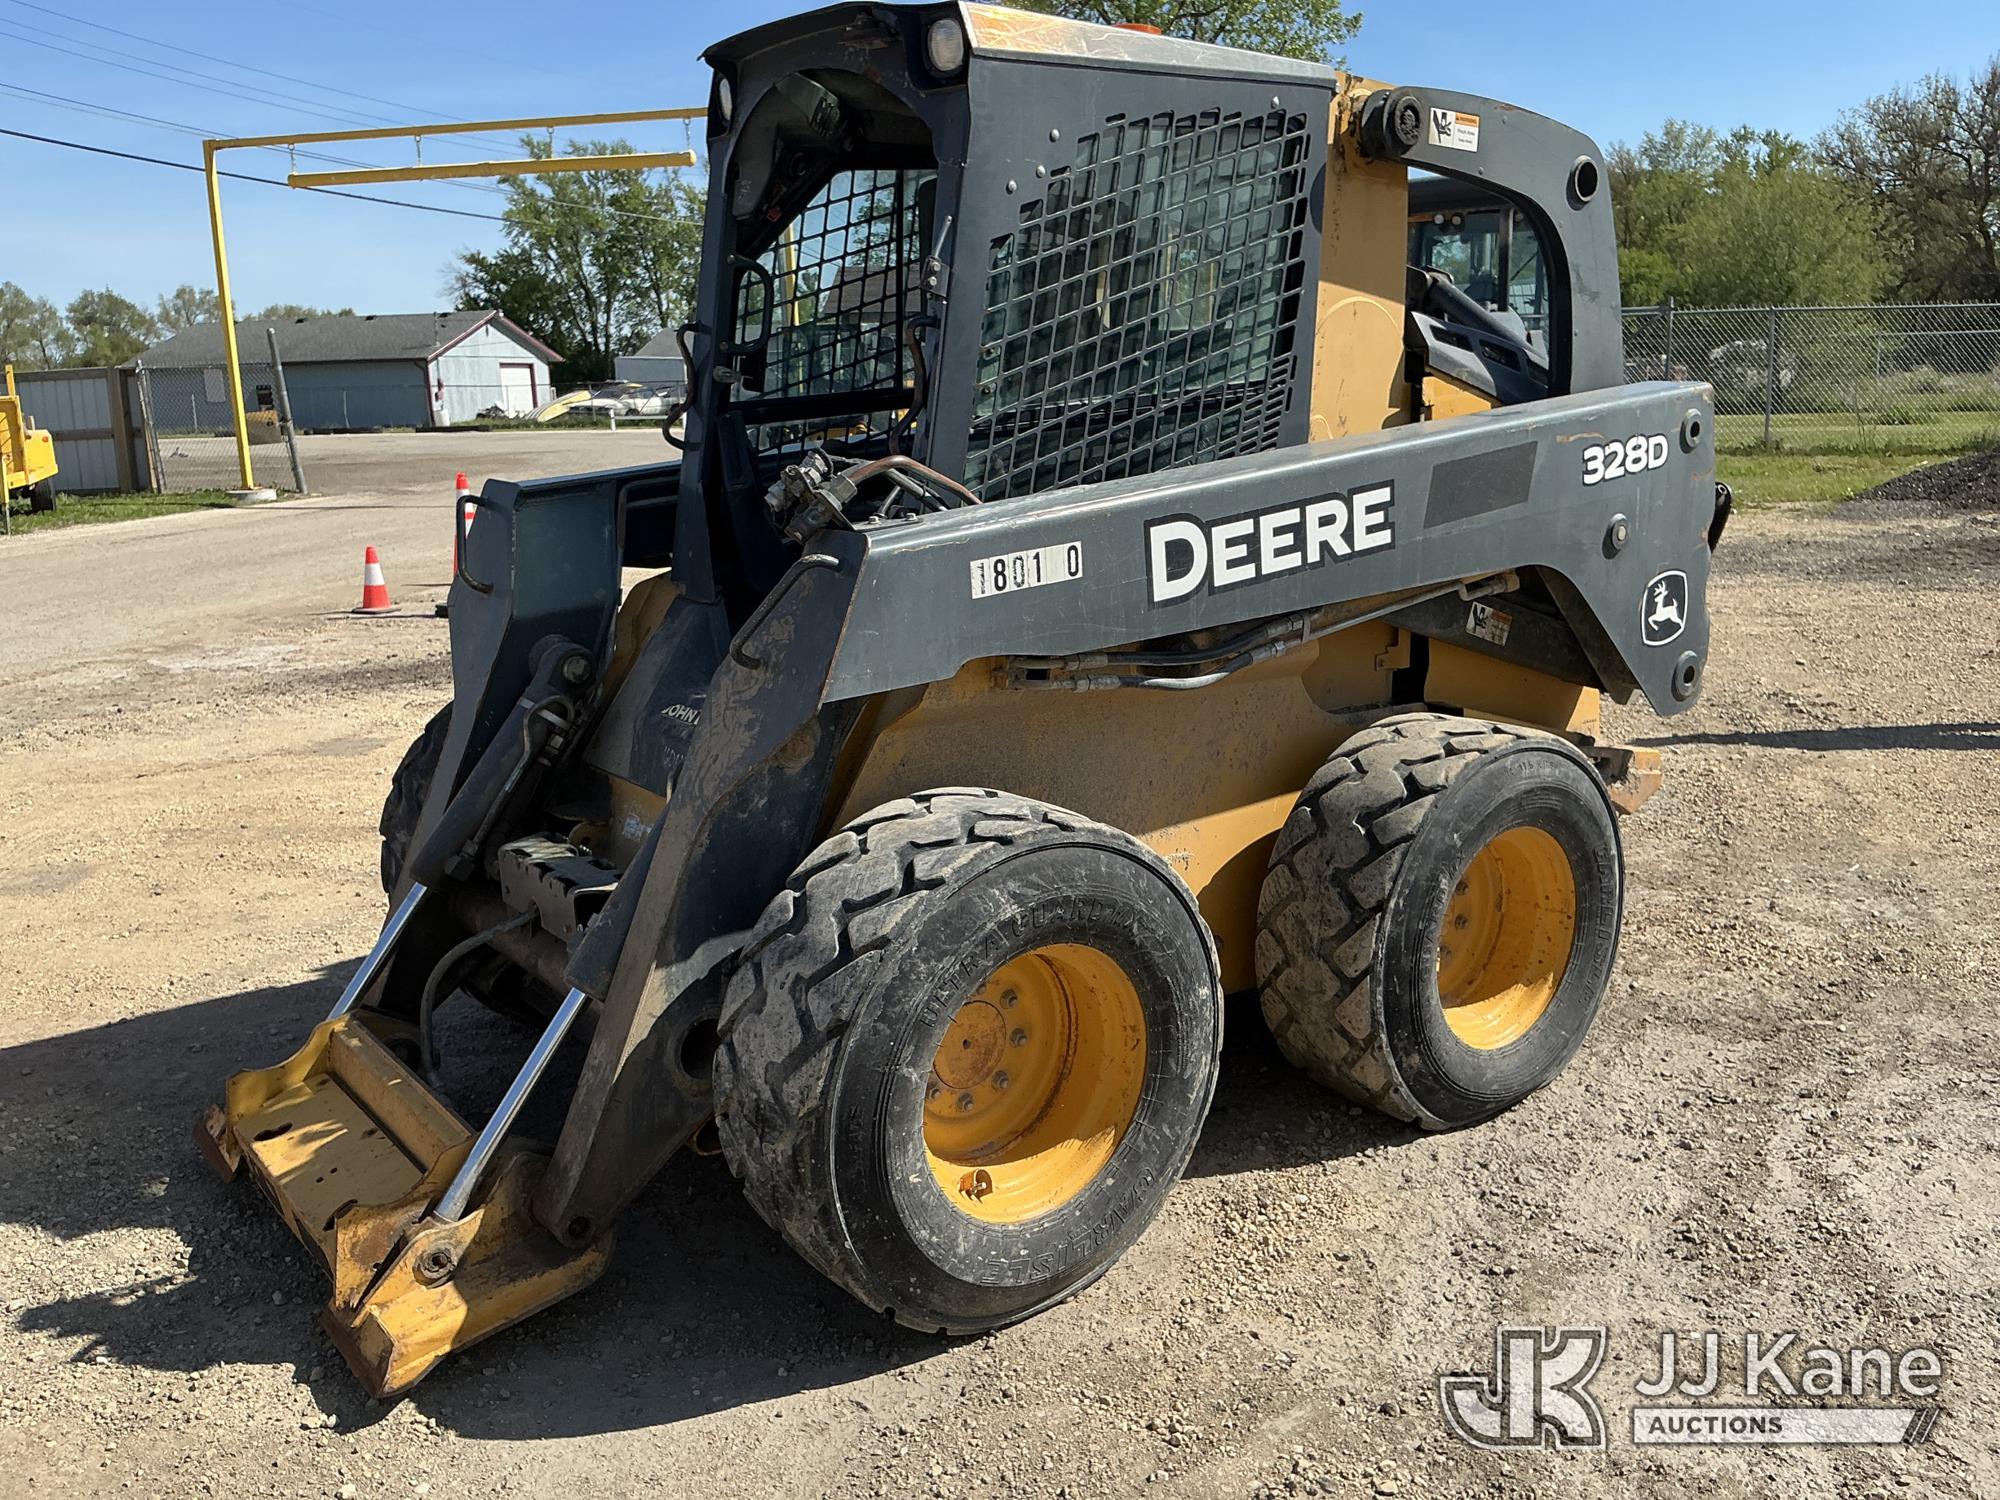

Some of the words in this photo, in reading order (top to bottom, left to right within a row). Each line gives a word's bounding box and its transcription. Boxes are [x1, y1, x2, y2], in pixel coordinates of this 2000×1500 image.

[1582, 433, 1670, 487] 328D
[1149, 486, 1392, 603] DEERE
[660, 703, 698, 723] JOHN
[979, 1166, 1156, 1287] CARLISLE
